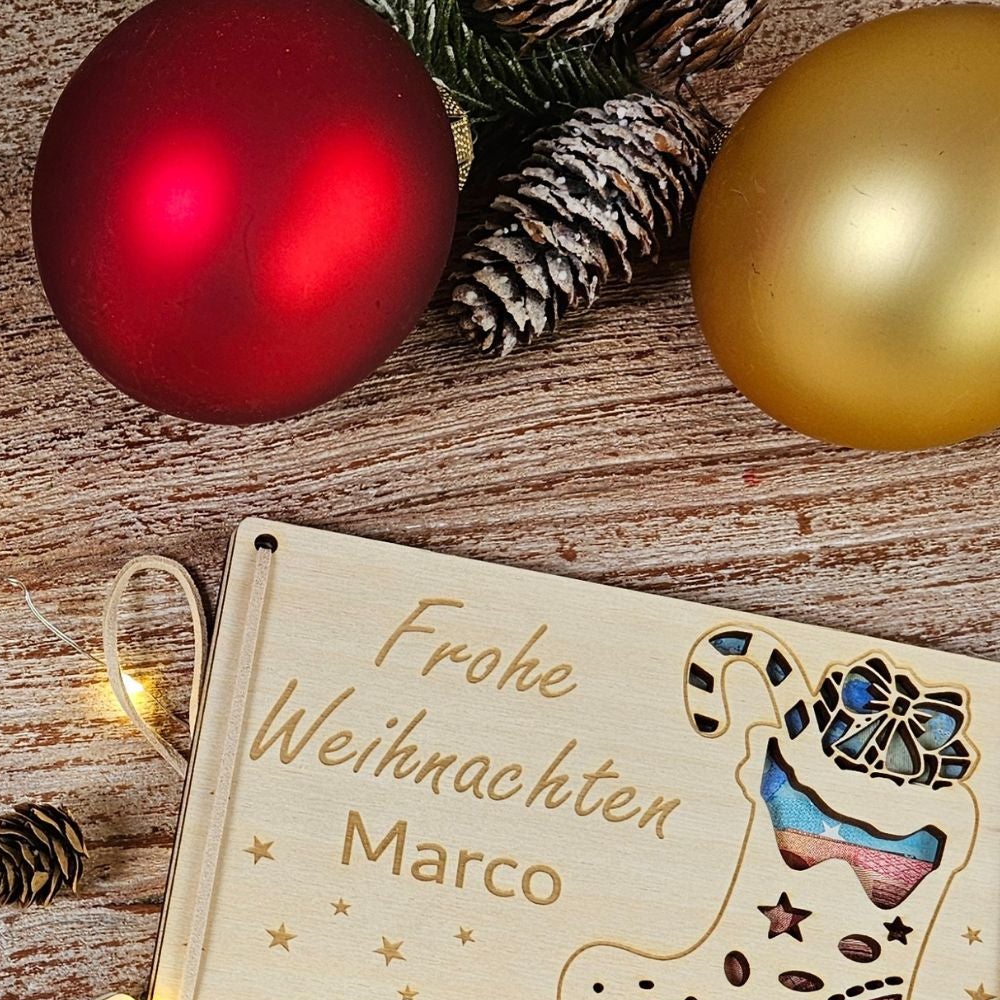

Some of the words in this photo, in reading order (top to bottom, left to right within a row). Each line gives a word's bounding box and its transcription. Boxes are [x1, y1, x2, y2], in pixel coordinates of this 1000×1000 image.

[374, 598, 578, 698] Frohe
[249, 678, 681, 840] Weihnachten
[341, 810, 562, 906] Marco
